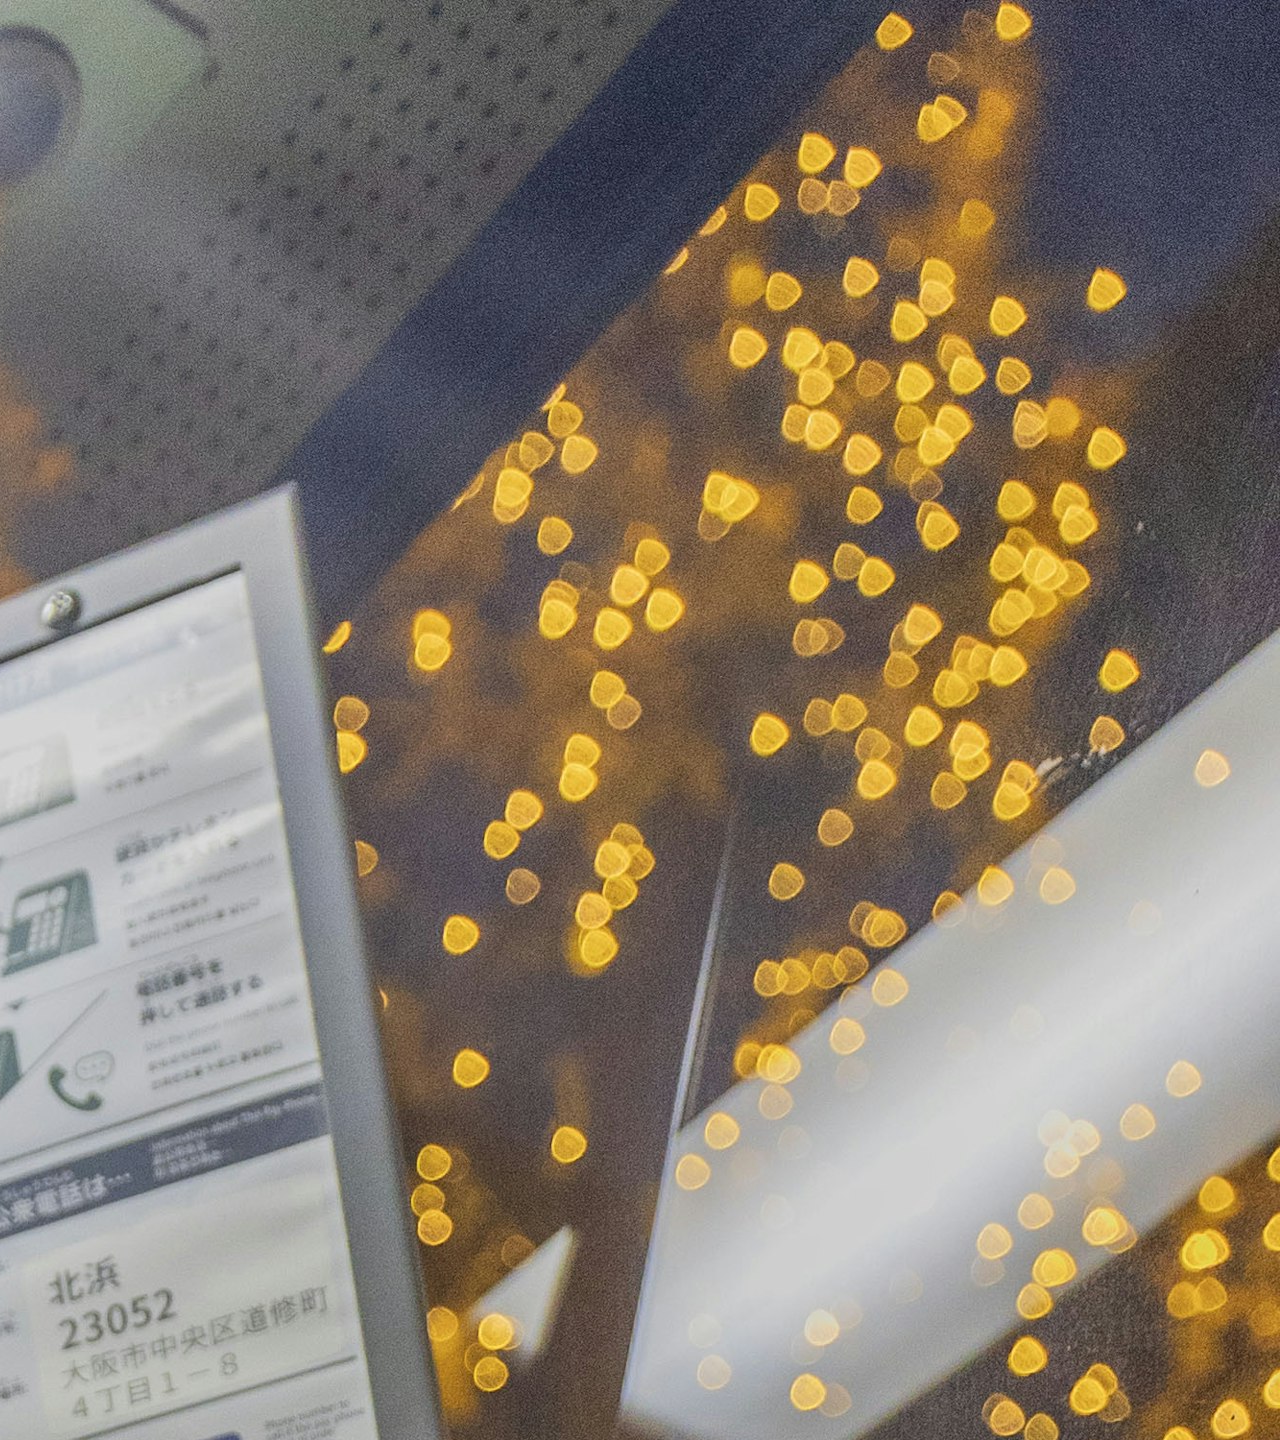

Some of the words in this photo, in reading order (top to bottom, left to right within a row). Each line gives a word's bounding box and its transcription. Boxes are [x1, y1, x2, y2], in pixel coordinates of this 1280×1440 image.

[48, 1256, 121, 1307] 北浜
[59, 1288, 178, 1351] 23052
[61, 1285, 330, 1389] 大阪市中央区道修町
